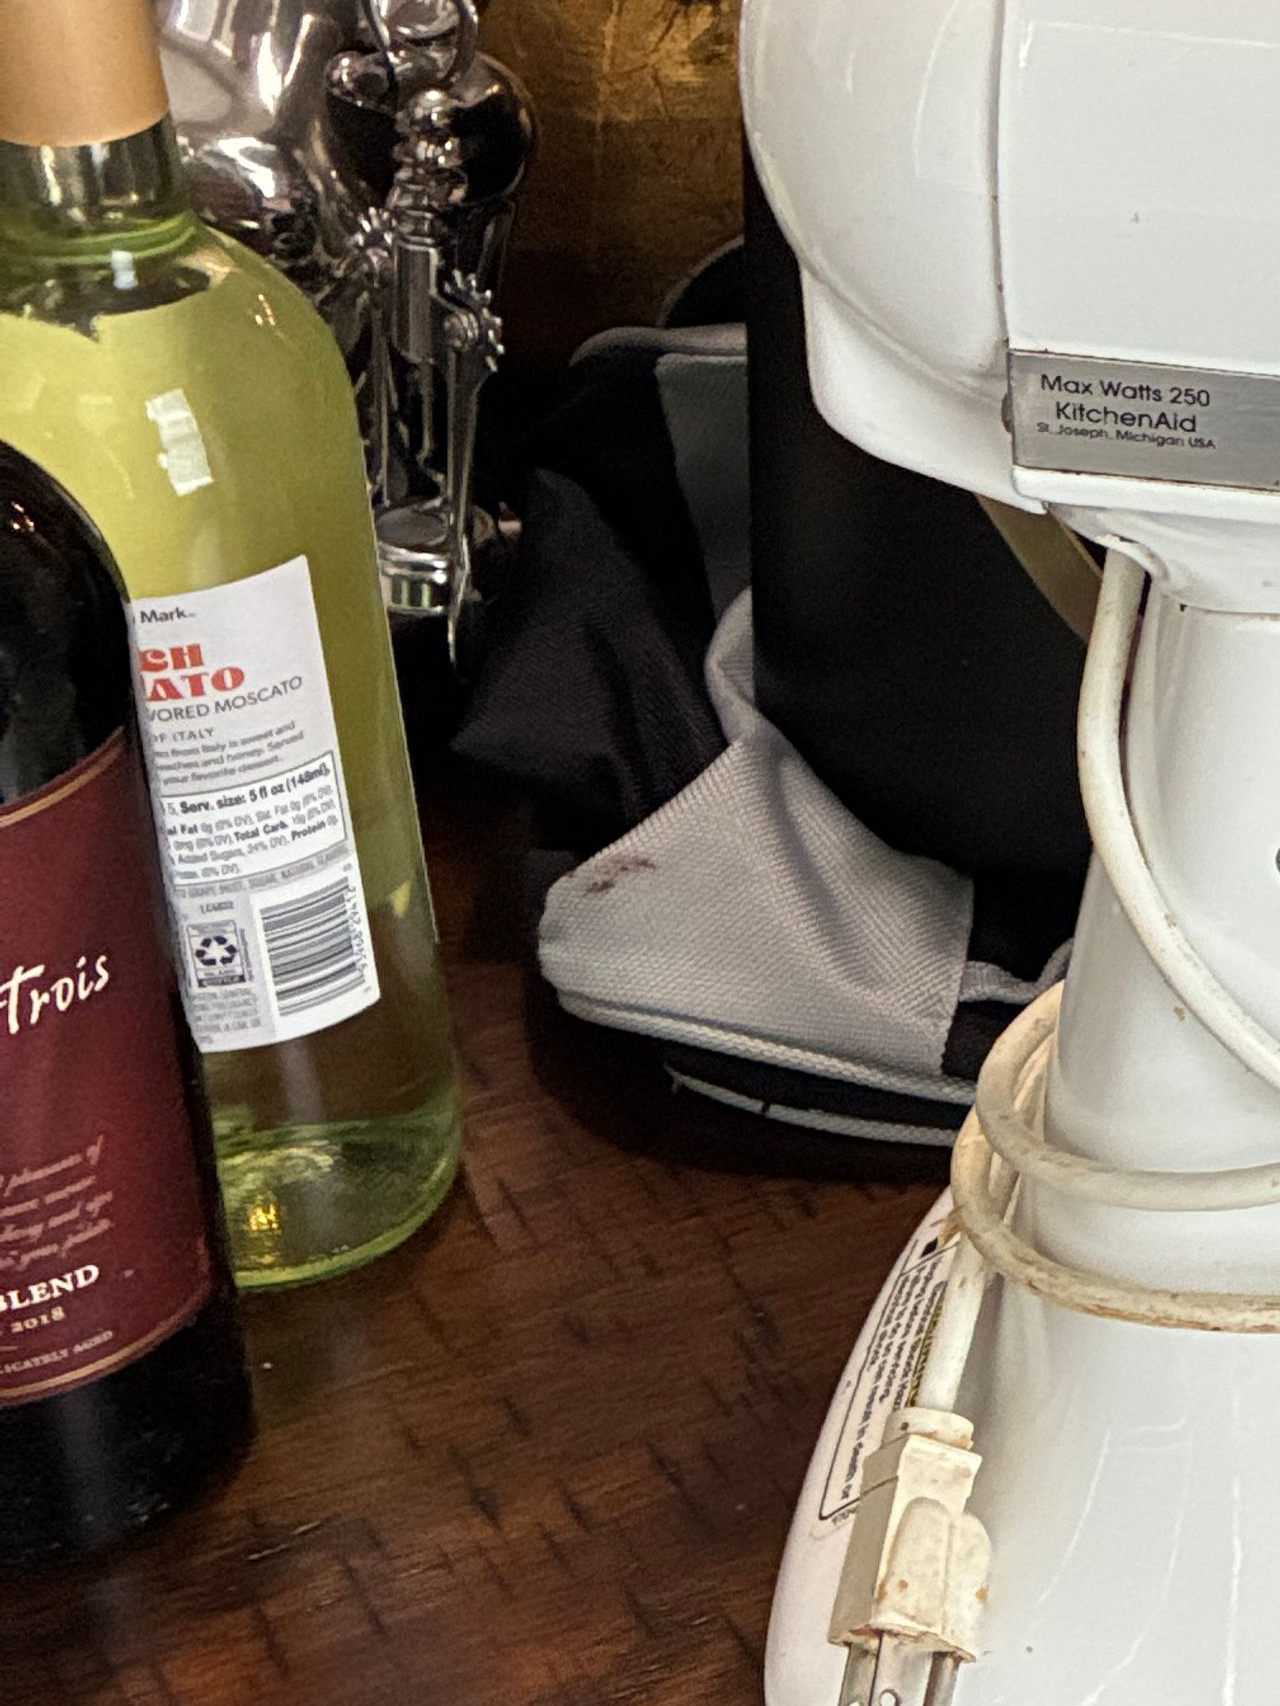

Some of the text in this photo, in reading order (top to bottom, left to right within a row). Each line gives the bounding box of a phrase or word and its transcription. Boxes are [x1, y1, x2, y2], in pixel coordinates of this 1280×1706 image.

[1040, 374, 1210, 407] Max Watts 250
[1055, 401, 1196, 432] KitchenAid
[1115, 429, 1184, 447] Michigan
[1188, 435, 1216, 449] USA
[139, 643, 205, 673] CH
[142, 666, 245, 702] ATO
[214, 676, 302, 714] MOSCATO
[172, 727, 214, 743] ITALY
[249, 789, 258, 803] 5
[260, 785, 269, 798] fl
[271, 782, 285, 795] oz
[0, 954, 109, 1035] Trois
